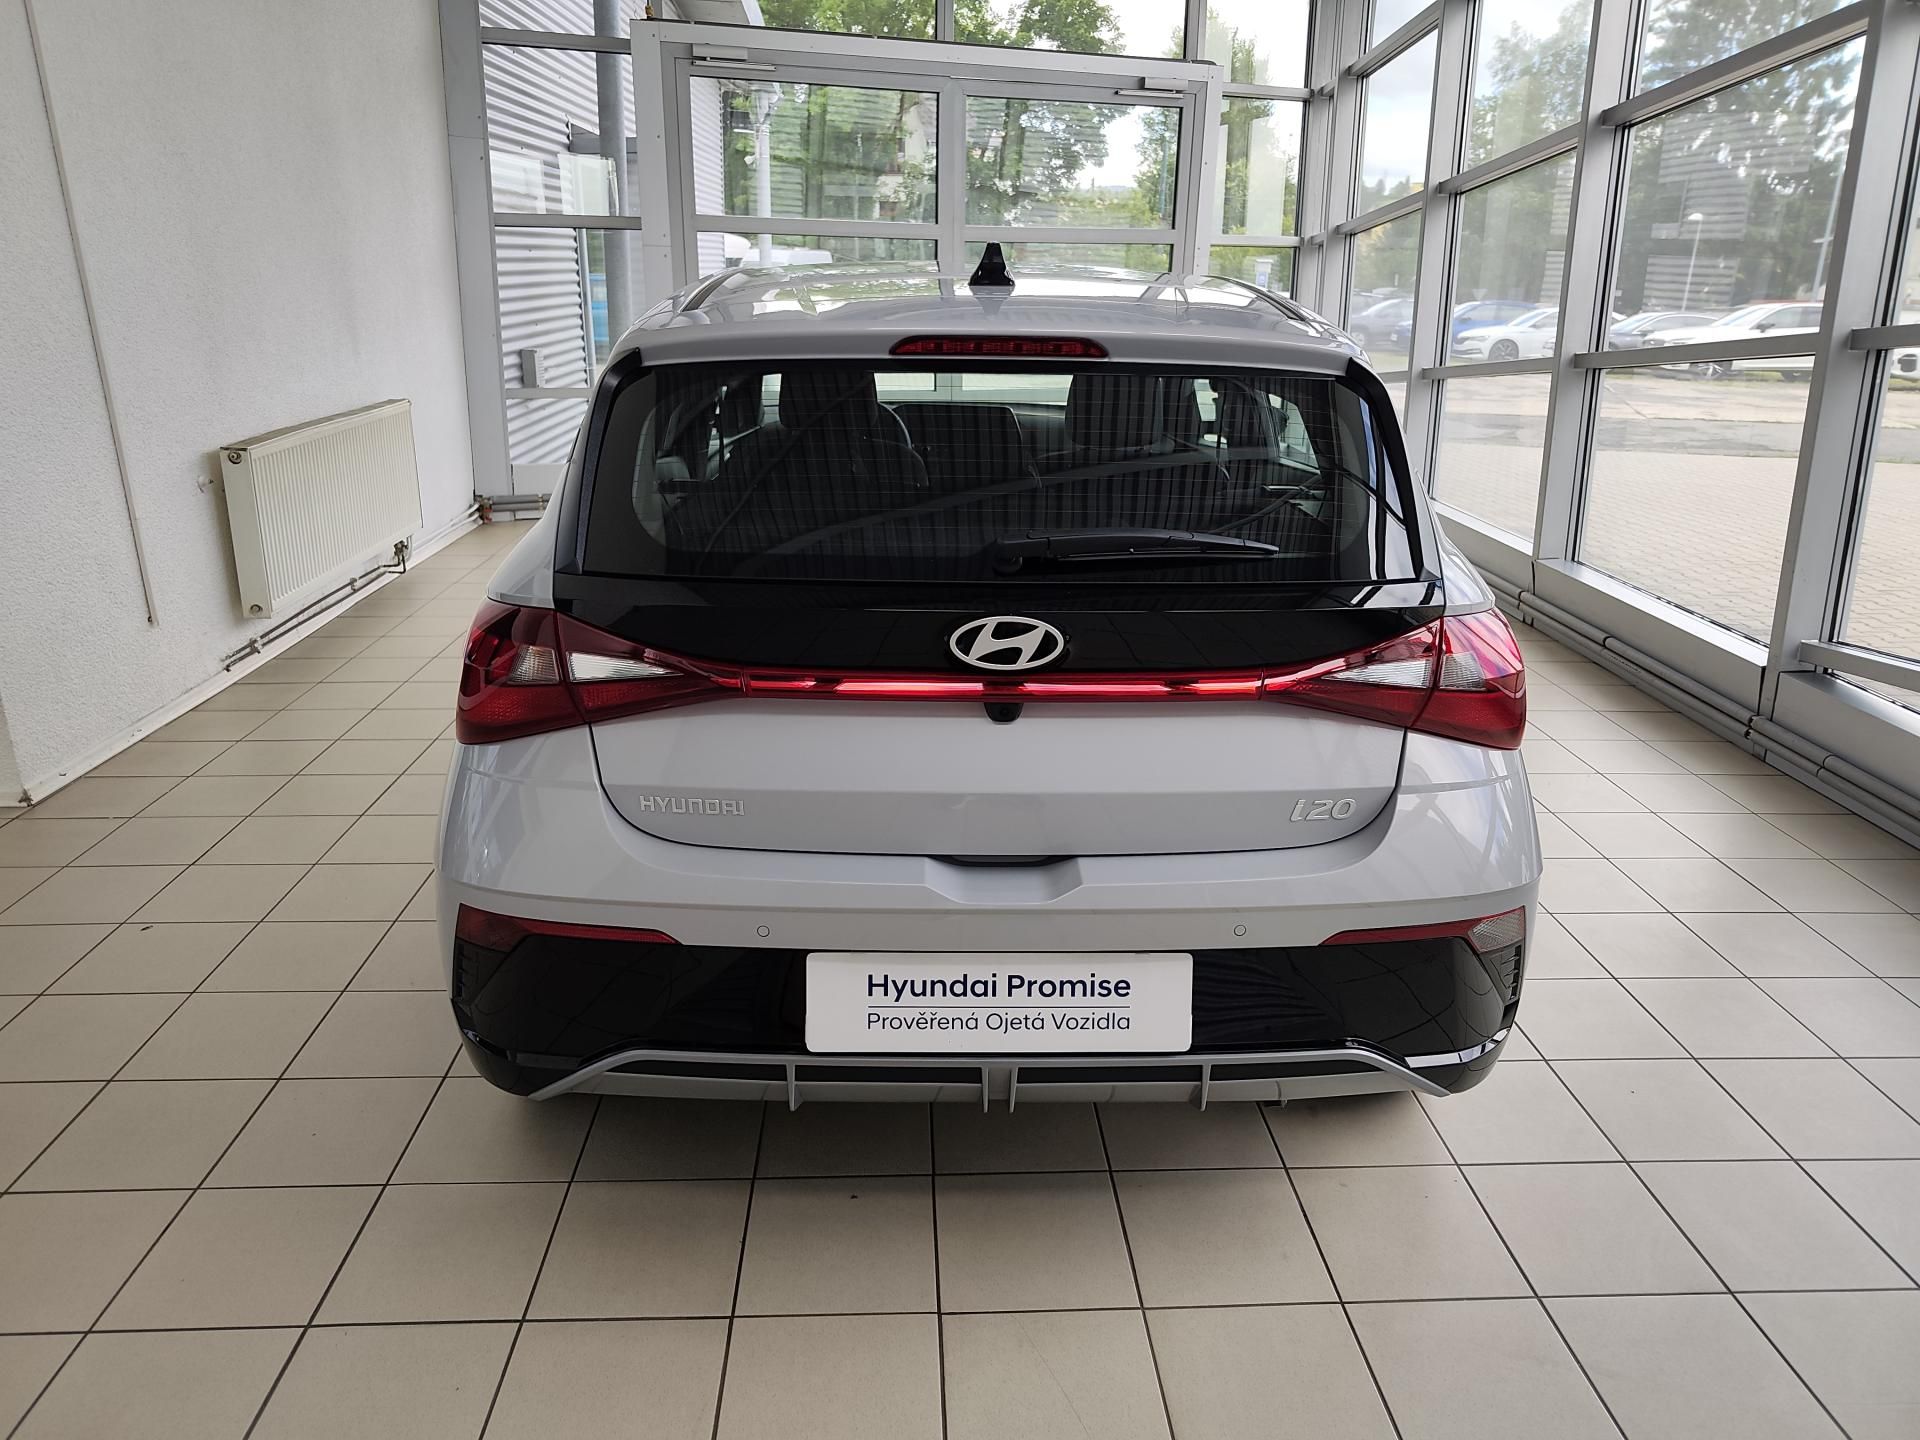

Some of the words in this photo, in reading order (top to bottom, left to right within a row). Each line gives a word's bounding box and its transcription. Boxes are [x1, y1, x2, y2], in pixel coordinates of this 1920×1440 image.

[639, 795, 745, 816] HYUNDAI
[867, 972, 997, 1003] Hyundai
[1007, 972, 1131, 998] Promise
[867, 1011, 979, 1031] Prověřená
[985, 1011, 1045, 1035] Ojetá
[1051, 1011, 1130, 1031] Vozidla
